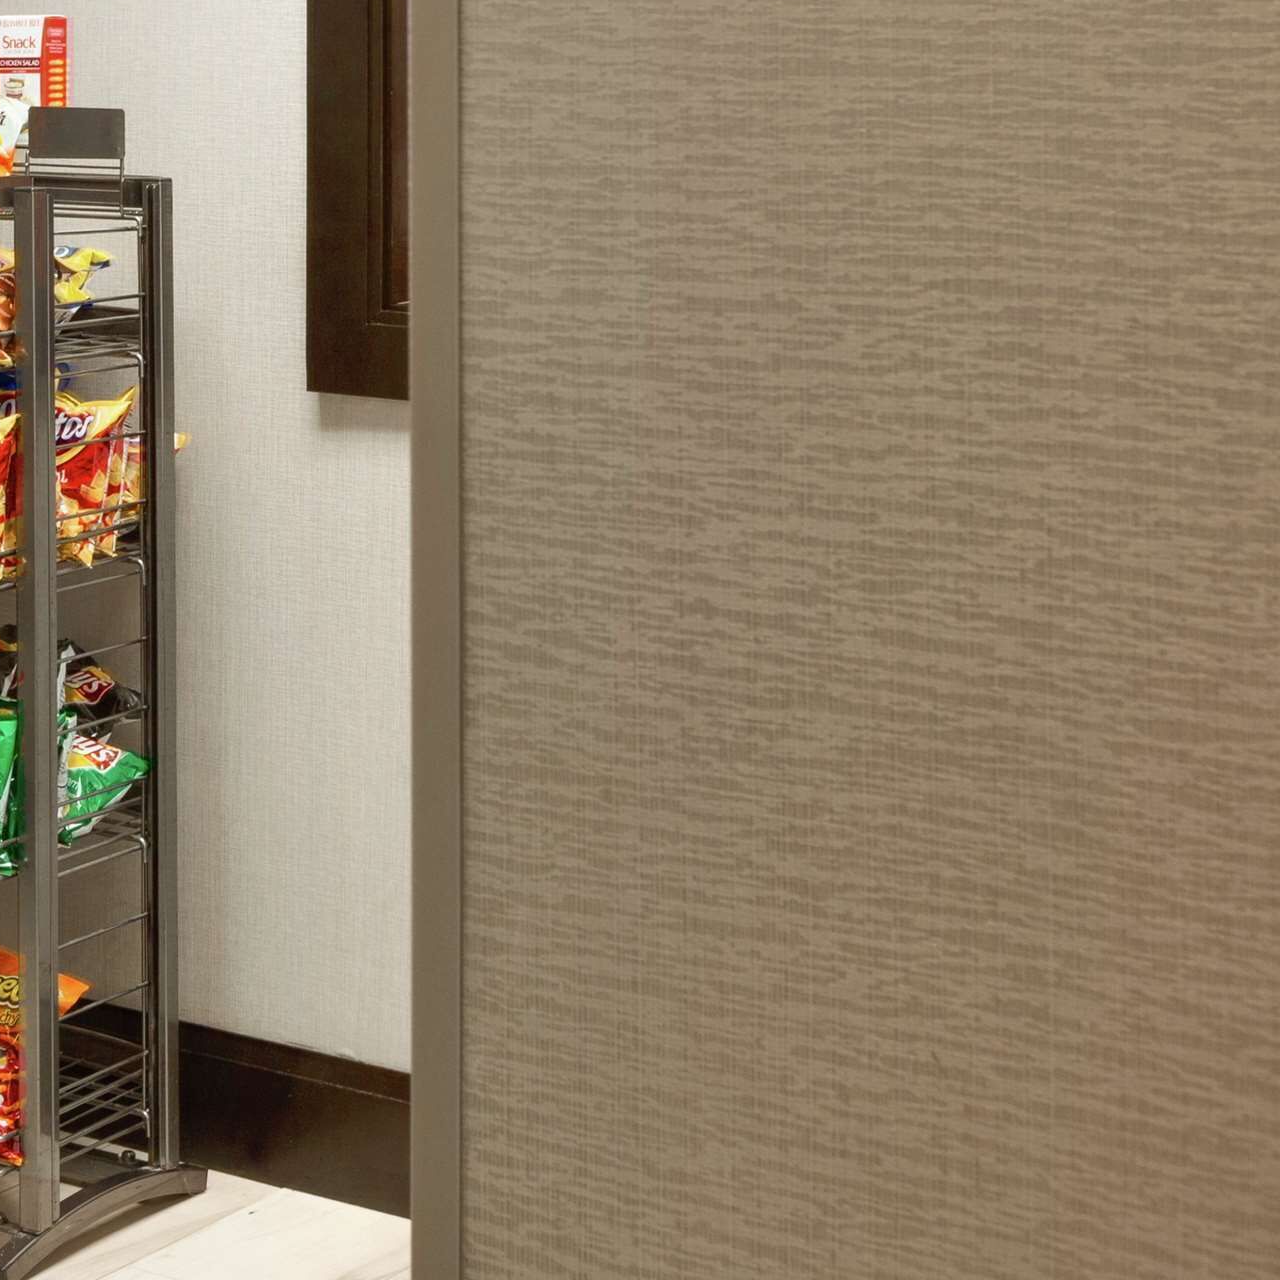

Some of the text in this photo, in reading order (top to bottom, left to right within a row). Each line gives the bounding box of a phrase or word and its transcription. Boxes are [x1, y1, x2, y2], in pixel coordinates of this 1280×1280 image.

[2, 35, 36, 49] Snack
[0, 59, 40, 68] CHICKEN SALAD
